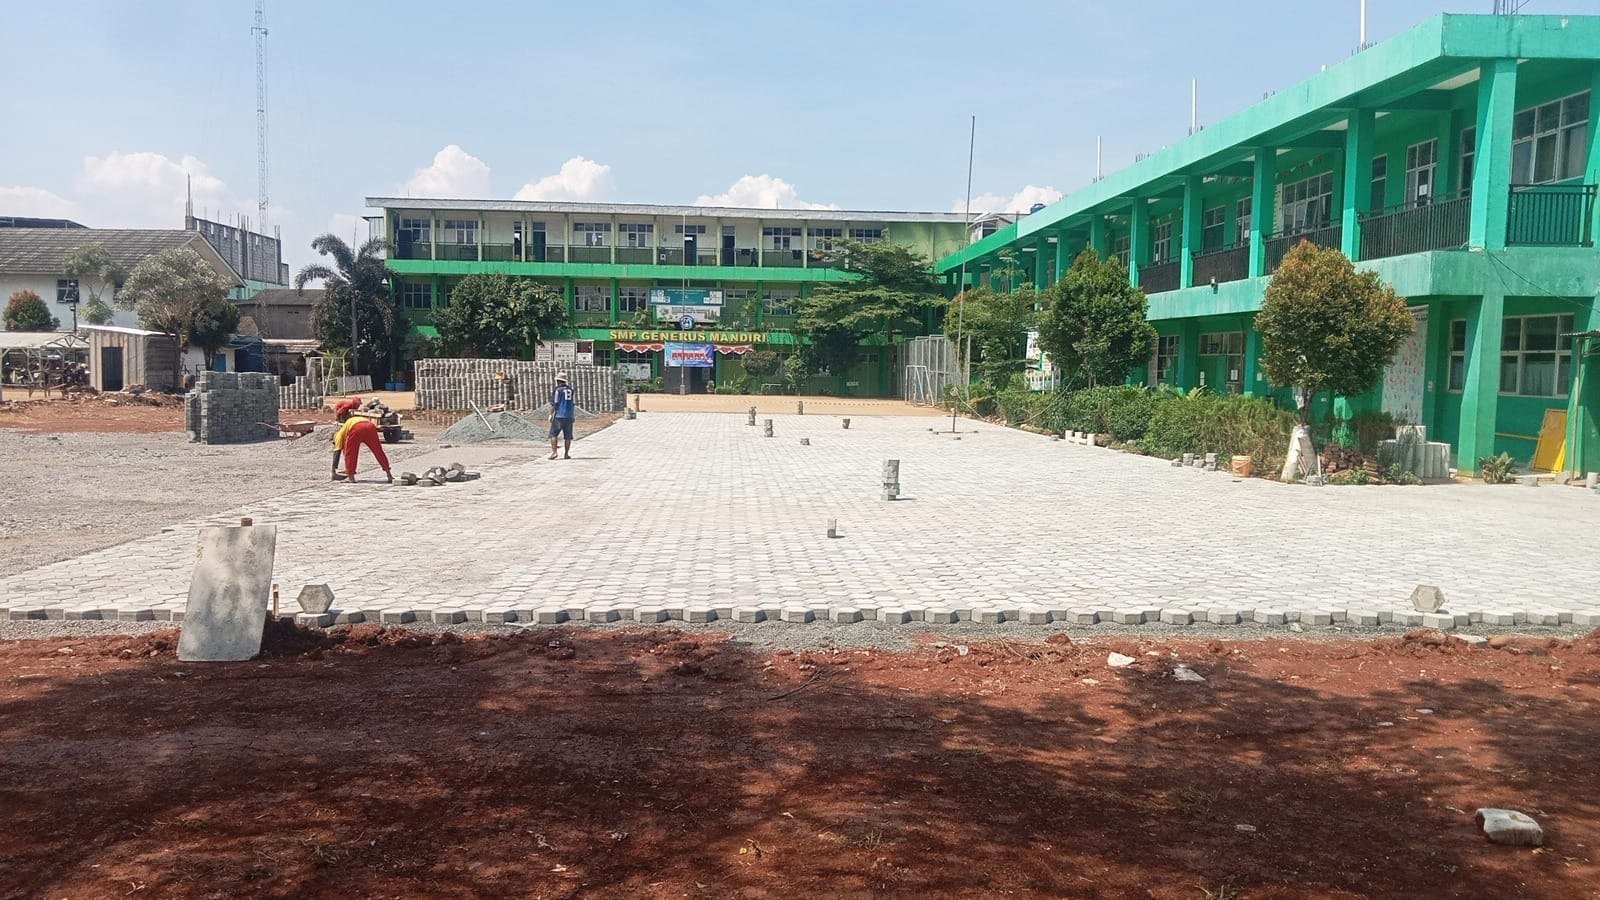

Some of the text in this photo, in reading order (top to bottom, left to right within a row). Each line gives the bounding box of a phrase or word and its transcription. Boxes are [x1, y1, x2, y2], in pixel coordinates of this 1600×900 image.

[610, 330, 766, 342] SMP GENERUS MANDIRI
